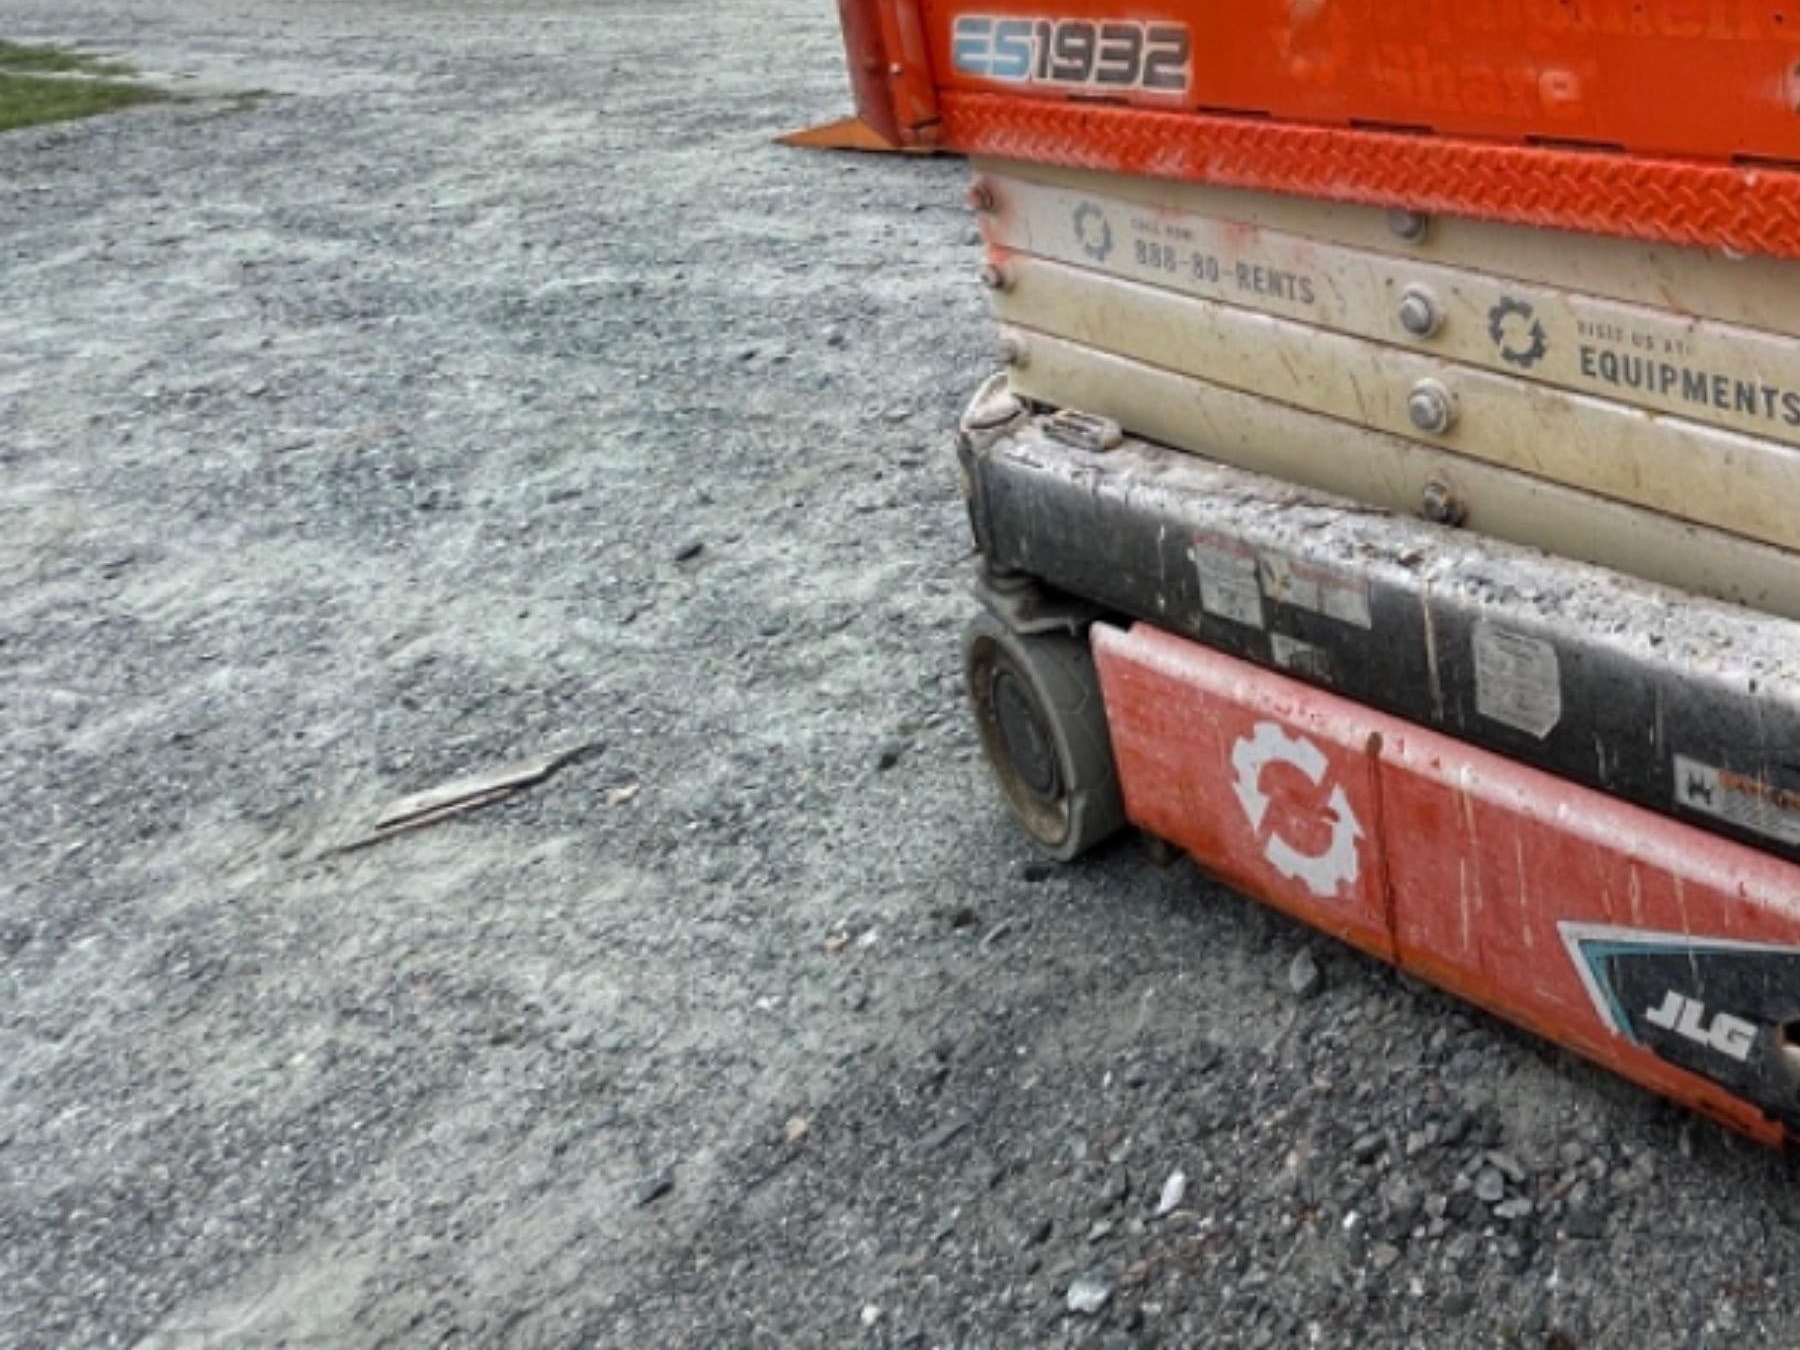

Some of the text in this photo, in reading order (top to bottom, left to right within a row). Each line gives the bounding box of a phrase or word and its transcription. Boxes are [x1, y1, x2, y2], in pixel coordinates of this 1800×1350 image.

[953, 16, 1192, 91] ES1932
[1135, 238, 1316, 305] 888-80-RENTS
[1646, 988, 1759, 1062] JLG
